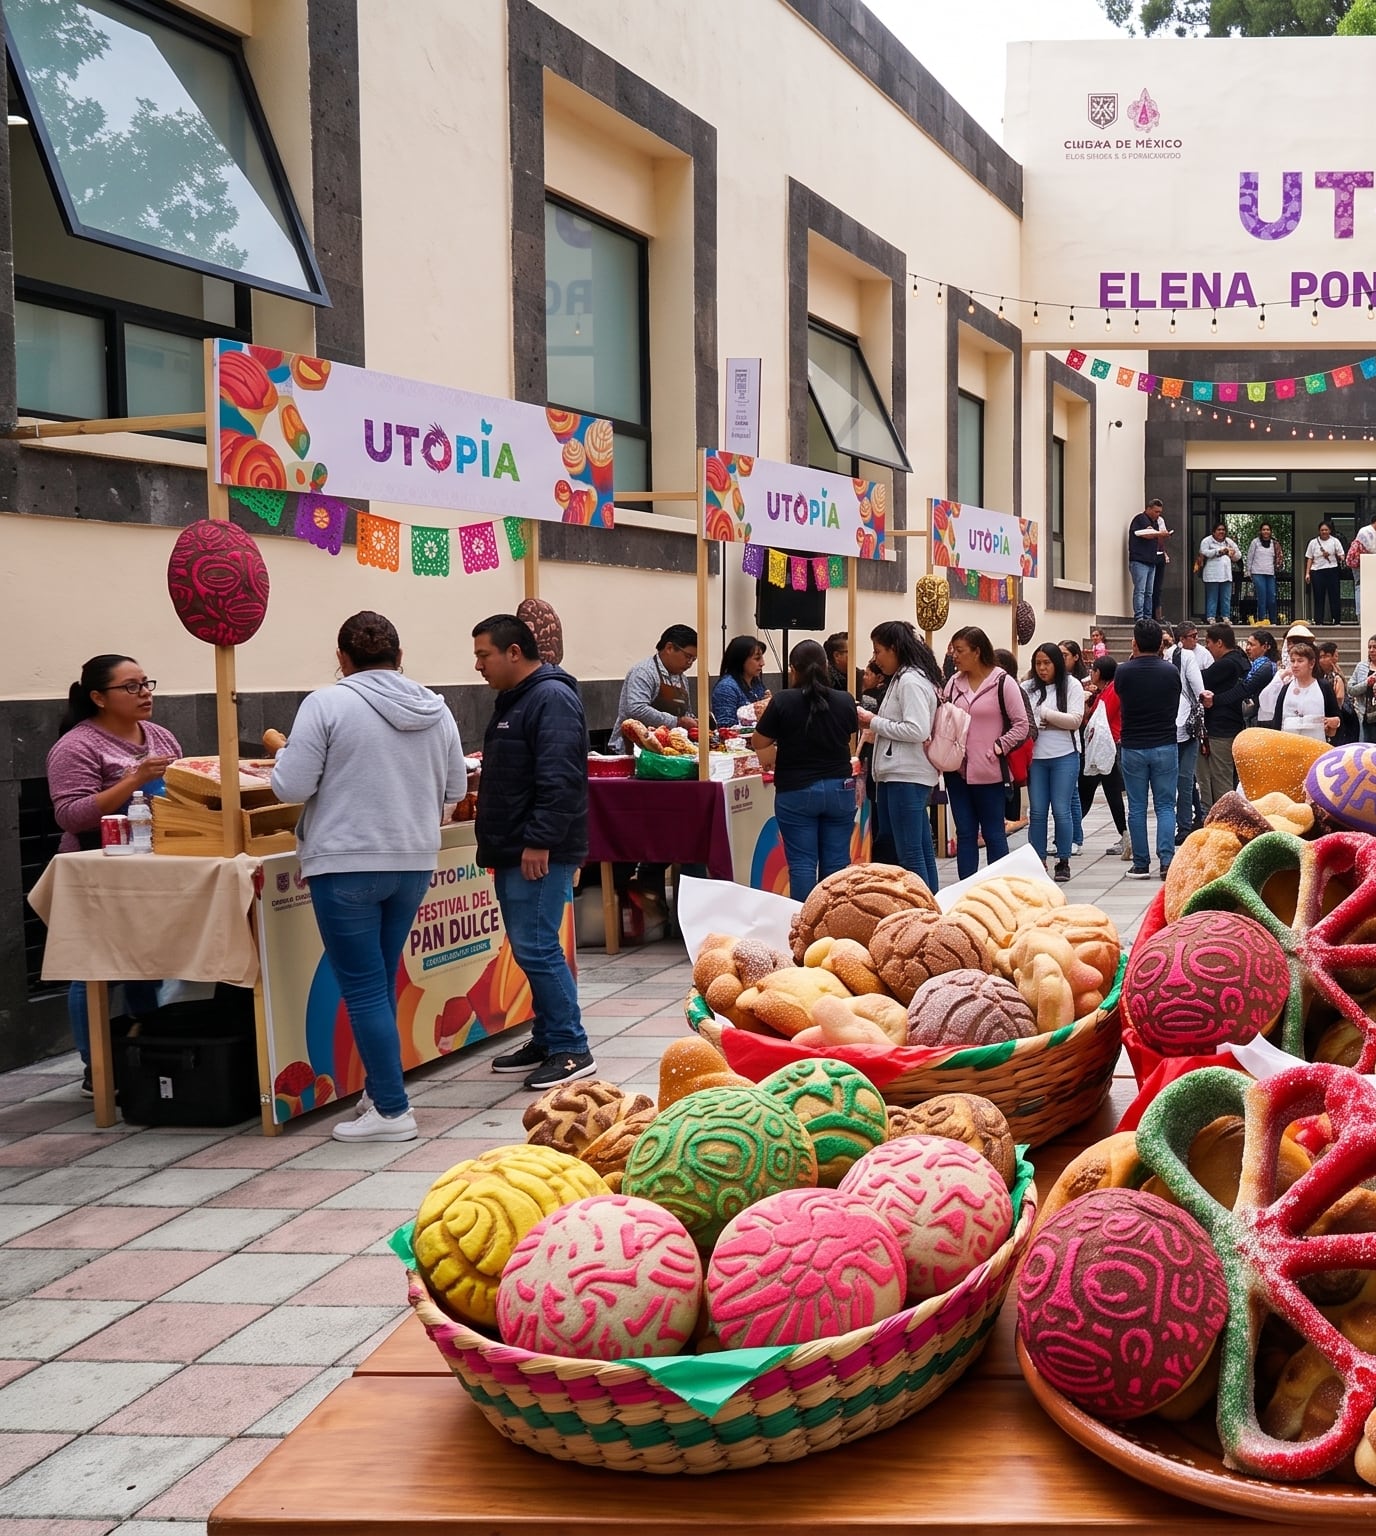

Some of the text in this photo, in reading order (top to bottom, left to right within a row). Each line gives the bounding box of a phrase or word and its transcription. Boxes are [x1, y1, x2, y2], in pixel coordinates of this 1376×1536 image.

[1115, 140, 1132, 149] DE
[1135, 137, 1183, 149] MÉXICO
[1100, 271, 1257, 308] ELENA
[417, 889, 492, 924] FESTIVAL DEL
[410, 922, 444, 956] PAN
[450, 908, 500, 945] DULCE
